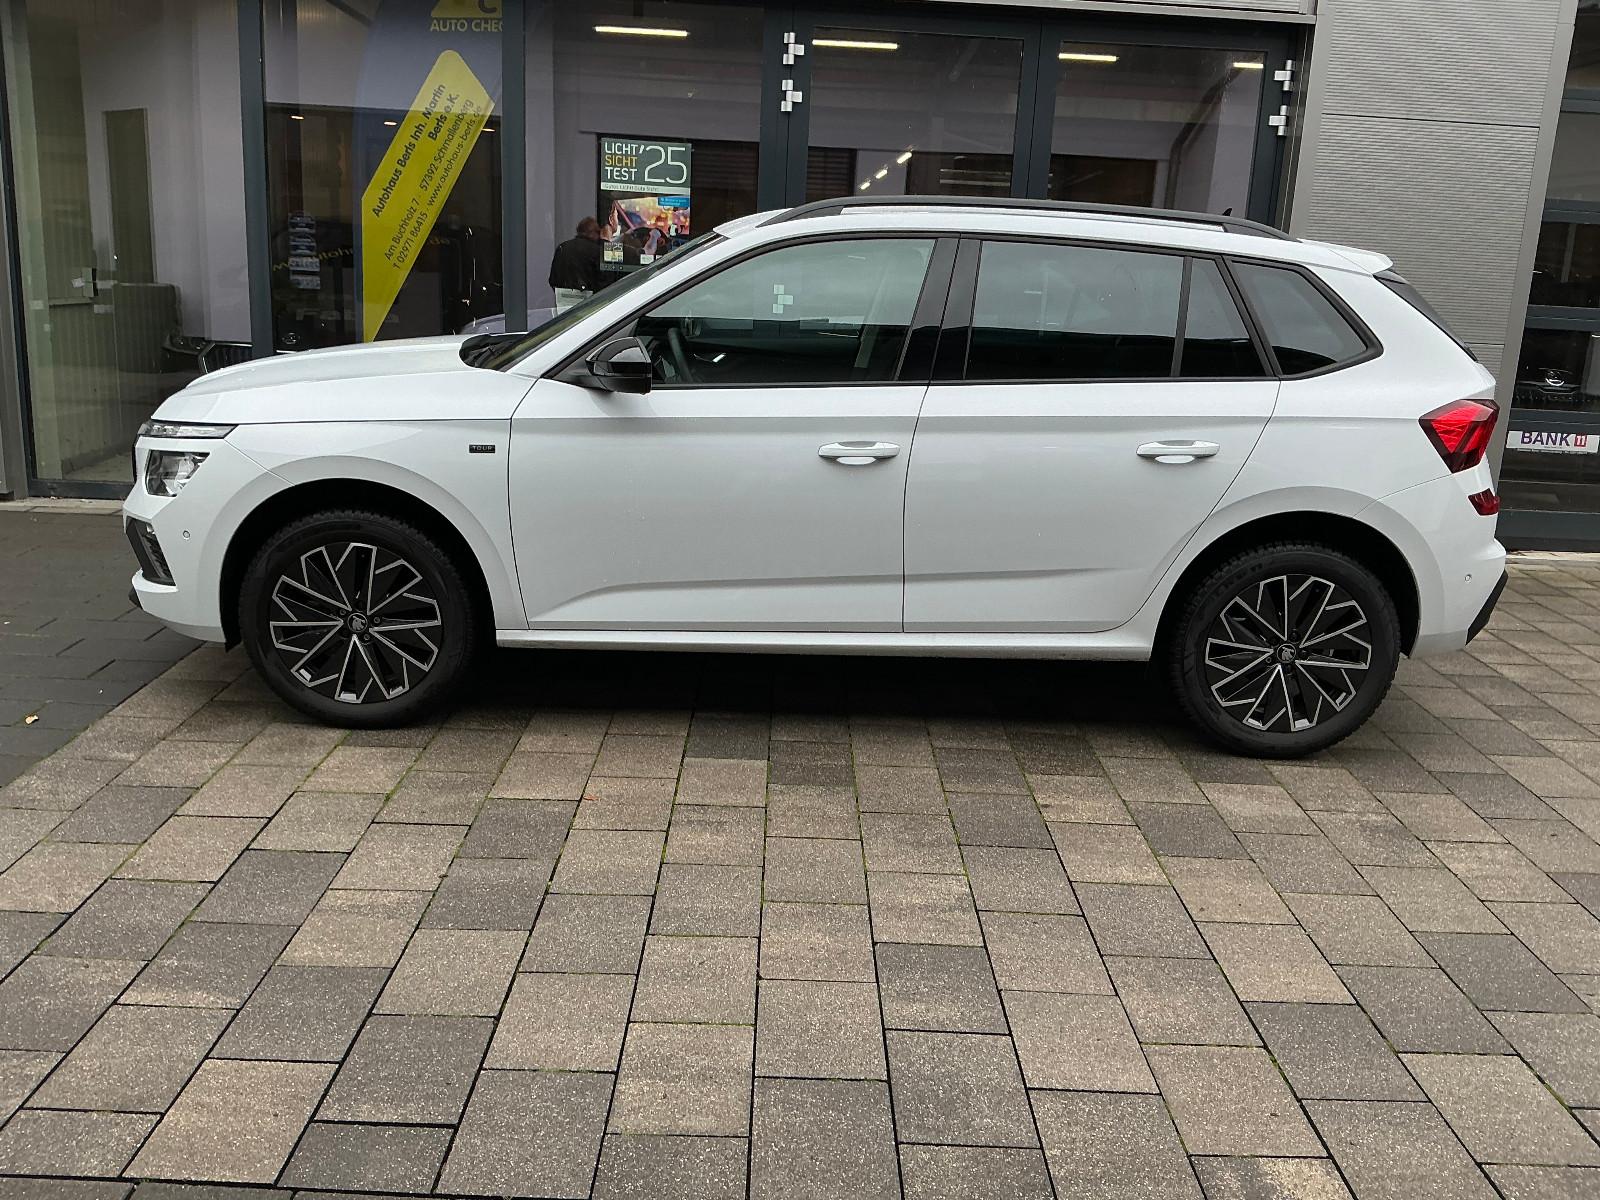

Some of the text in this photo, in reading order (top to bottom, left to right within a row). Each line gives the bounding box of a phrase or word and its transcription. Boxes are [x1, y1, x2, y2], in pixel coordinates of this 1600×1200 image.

[430, 19, 468, 32] AUTO
[428, 114, 447, 141] Berls
[372, 84, 446, 217] Autohaus Berls Inh. Martin
[604, 141, 638, 155] LICHT
[604, 154, 638, 167] SICHT
[384, 99, 474, 261] Am Buchholz 7 57392 Schmallenberg
[604, 167, 638, 181] TEST
[410, 210, 428, 238] 86415
[1520, 431, 1570, 446] BANK
